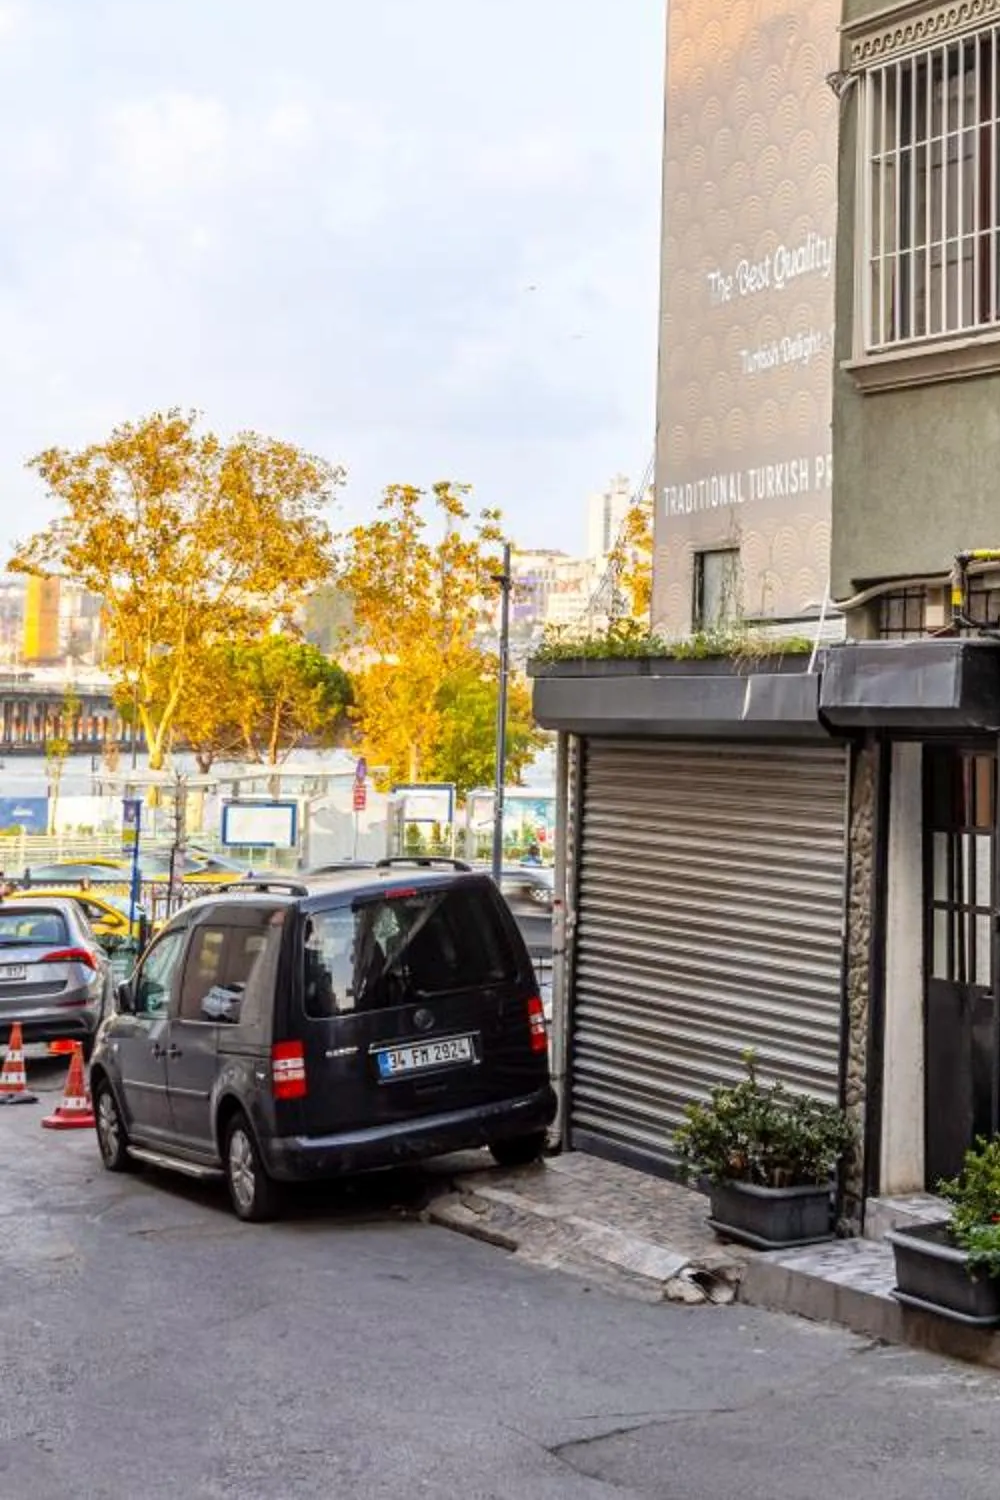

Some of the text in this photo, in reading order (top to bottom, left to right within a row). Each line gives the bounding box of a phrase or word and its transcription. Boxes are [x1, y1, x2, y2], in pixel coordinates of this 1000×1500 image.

[708, 232, 832, 301] The Best Quality
[664, 471, 745, 517] TRADITIONAL
[748, 457, 810, 500] TURKISH
[389, 1049, 406, 1069] 34
[411, 1046, 430, 1067] FM
